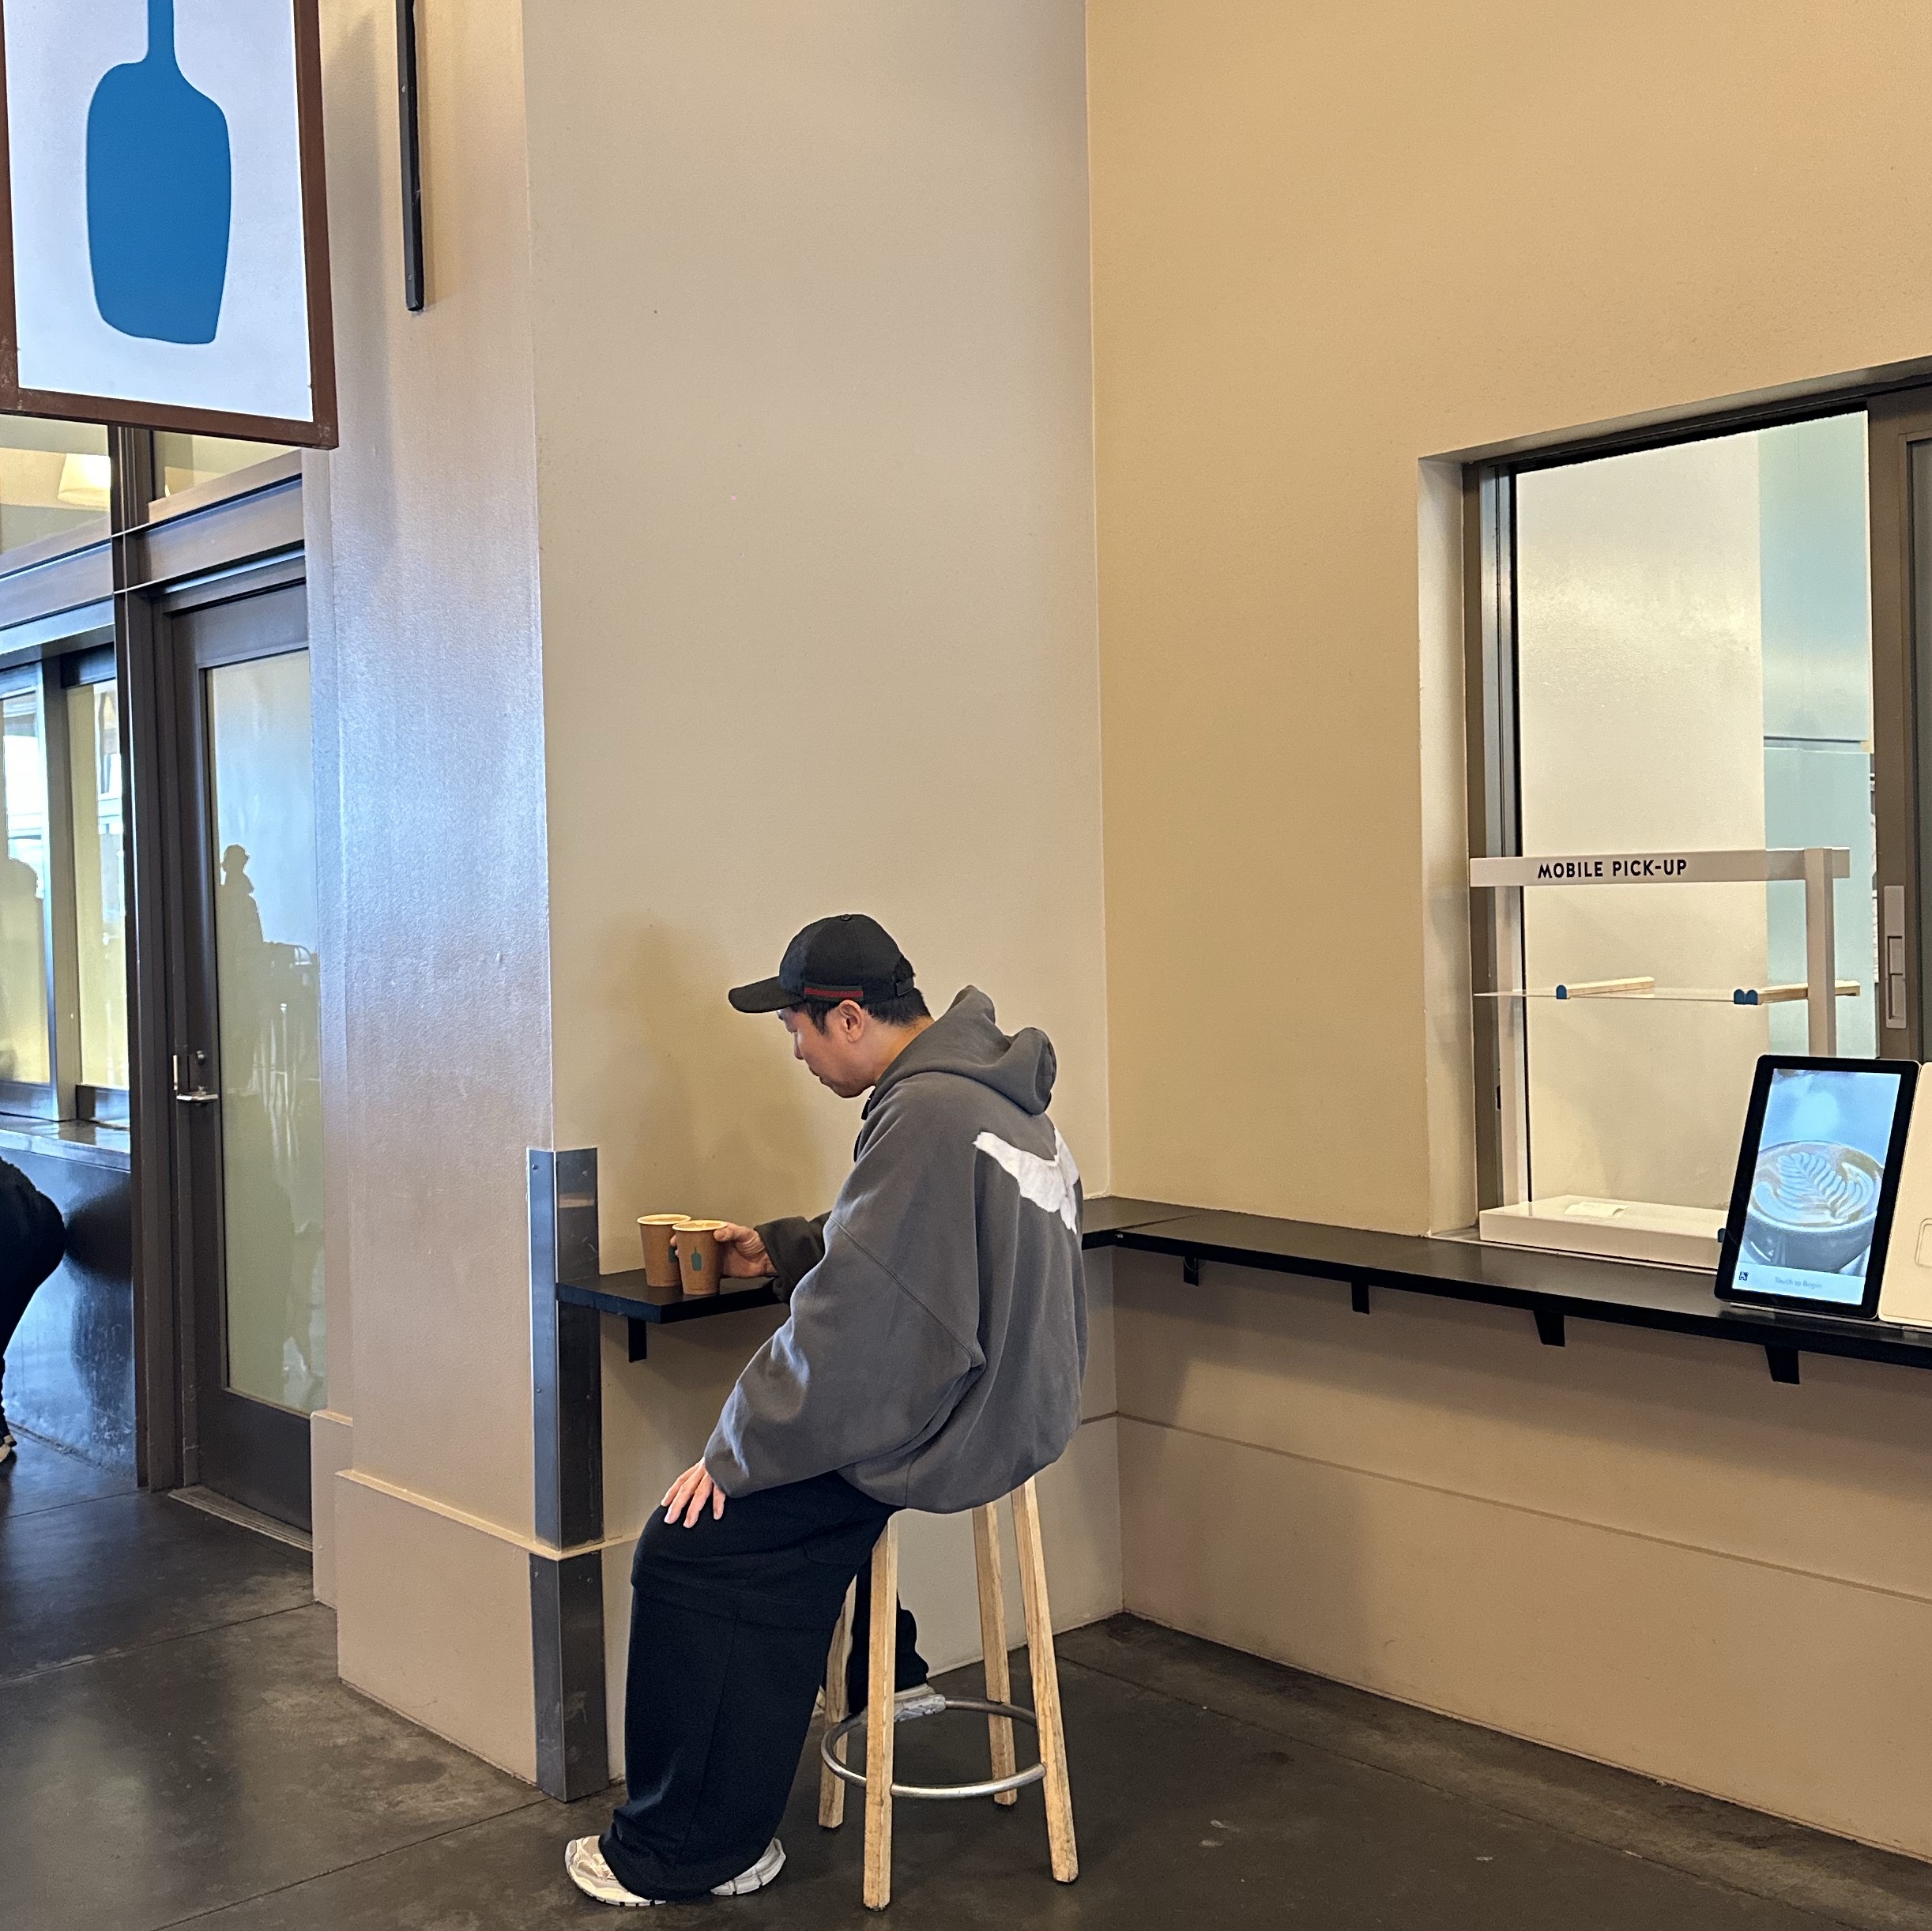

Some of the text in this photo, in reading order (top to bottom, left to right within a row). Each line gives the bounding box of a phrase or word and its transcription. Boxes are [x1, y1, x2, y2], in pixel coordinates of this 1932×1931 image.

[1538, 859, 1687, 879] MOBILE PICK-UP
[1774, 1276, 1794, 1285] Touch
[1802, 1280, 1822, 1290] Begin
